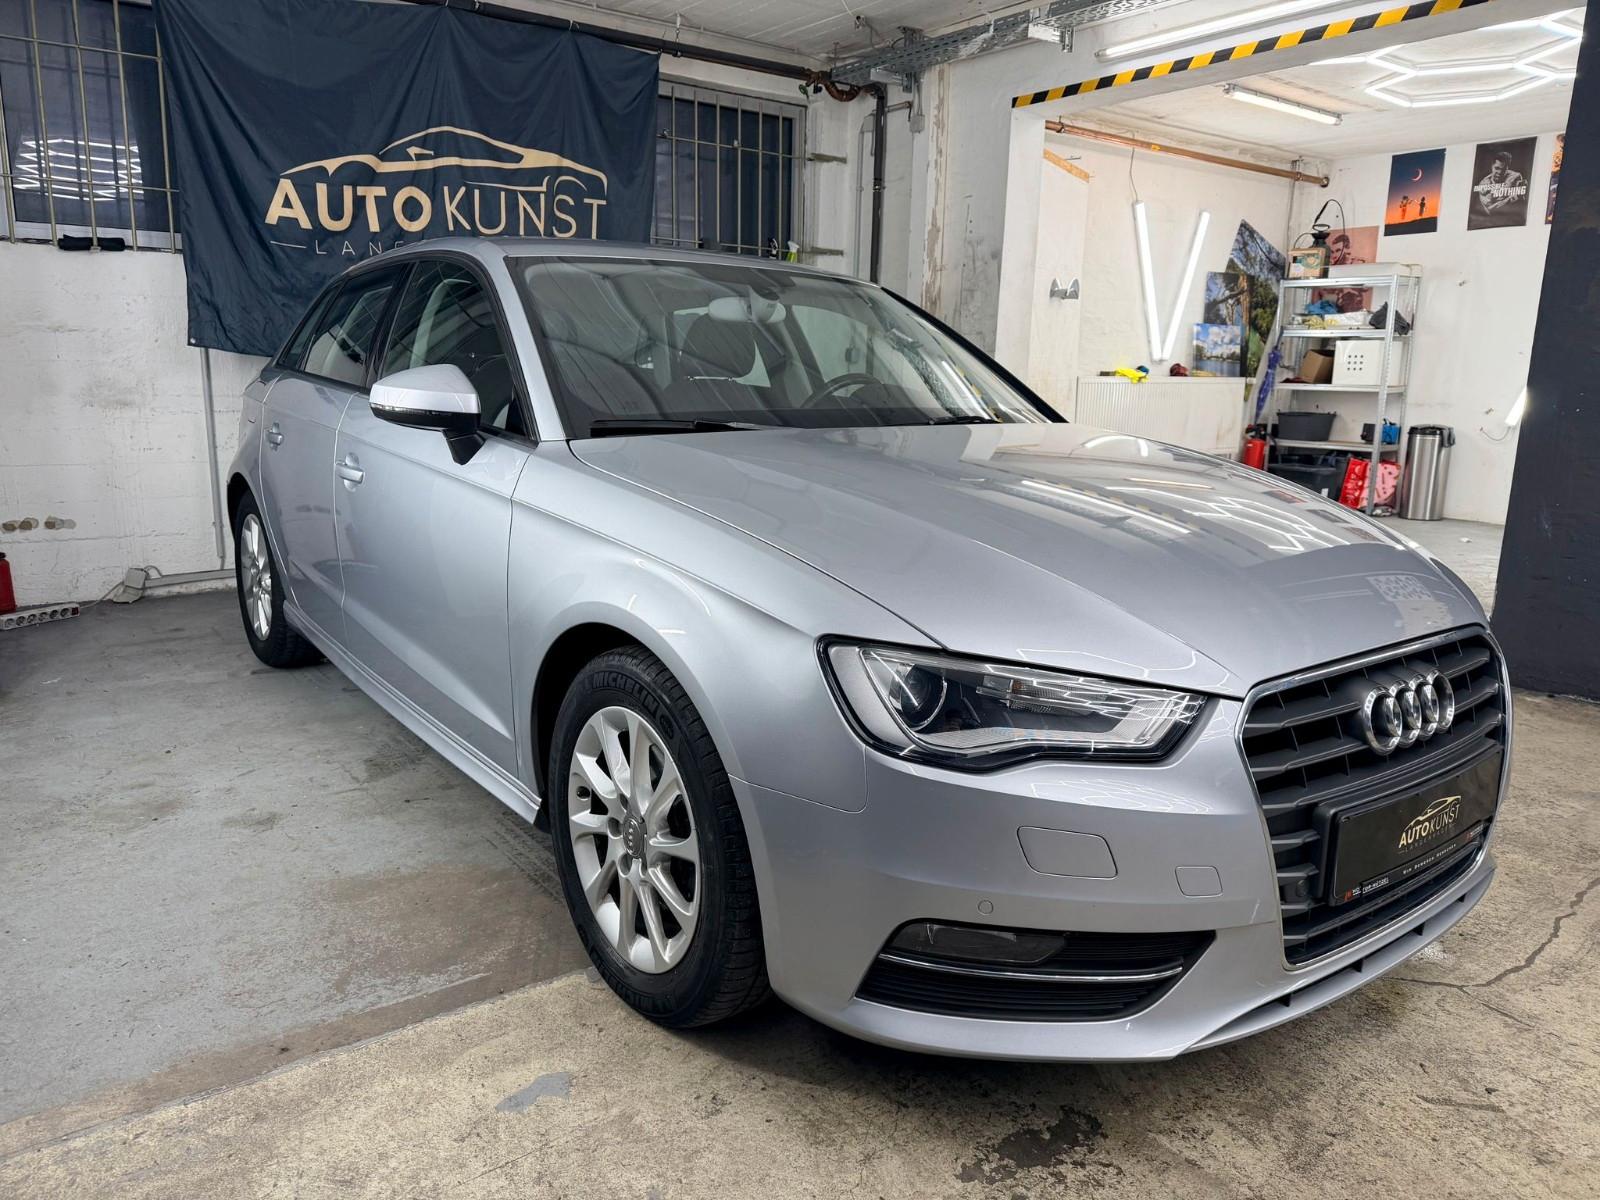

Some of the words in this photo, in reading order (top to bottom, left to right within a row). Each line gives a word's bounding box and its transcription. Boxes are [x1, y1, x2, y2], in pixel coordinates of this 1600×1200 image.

[1493, 185, 1526, 198] NOTHING
[593, 672, 660, 718] MICHELIN
[1398, 804, 1460, 849] AUTOKUNST
